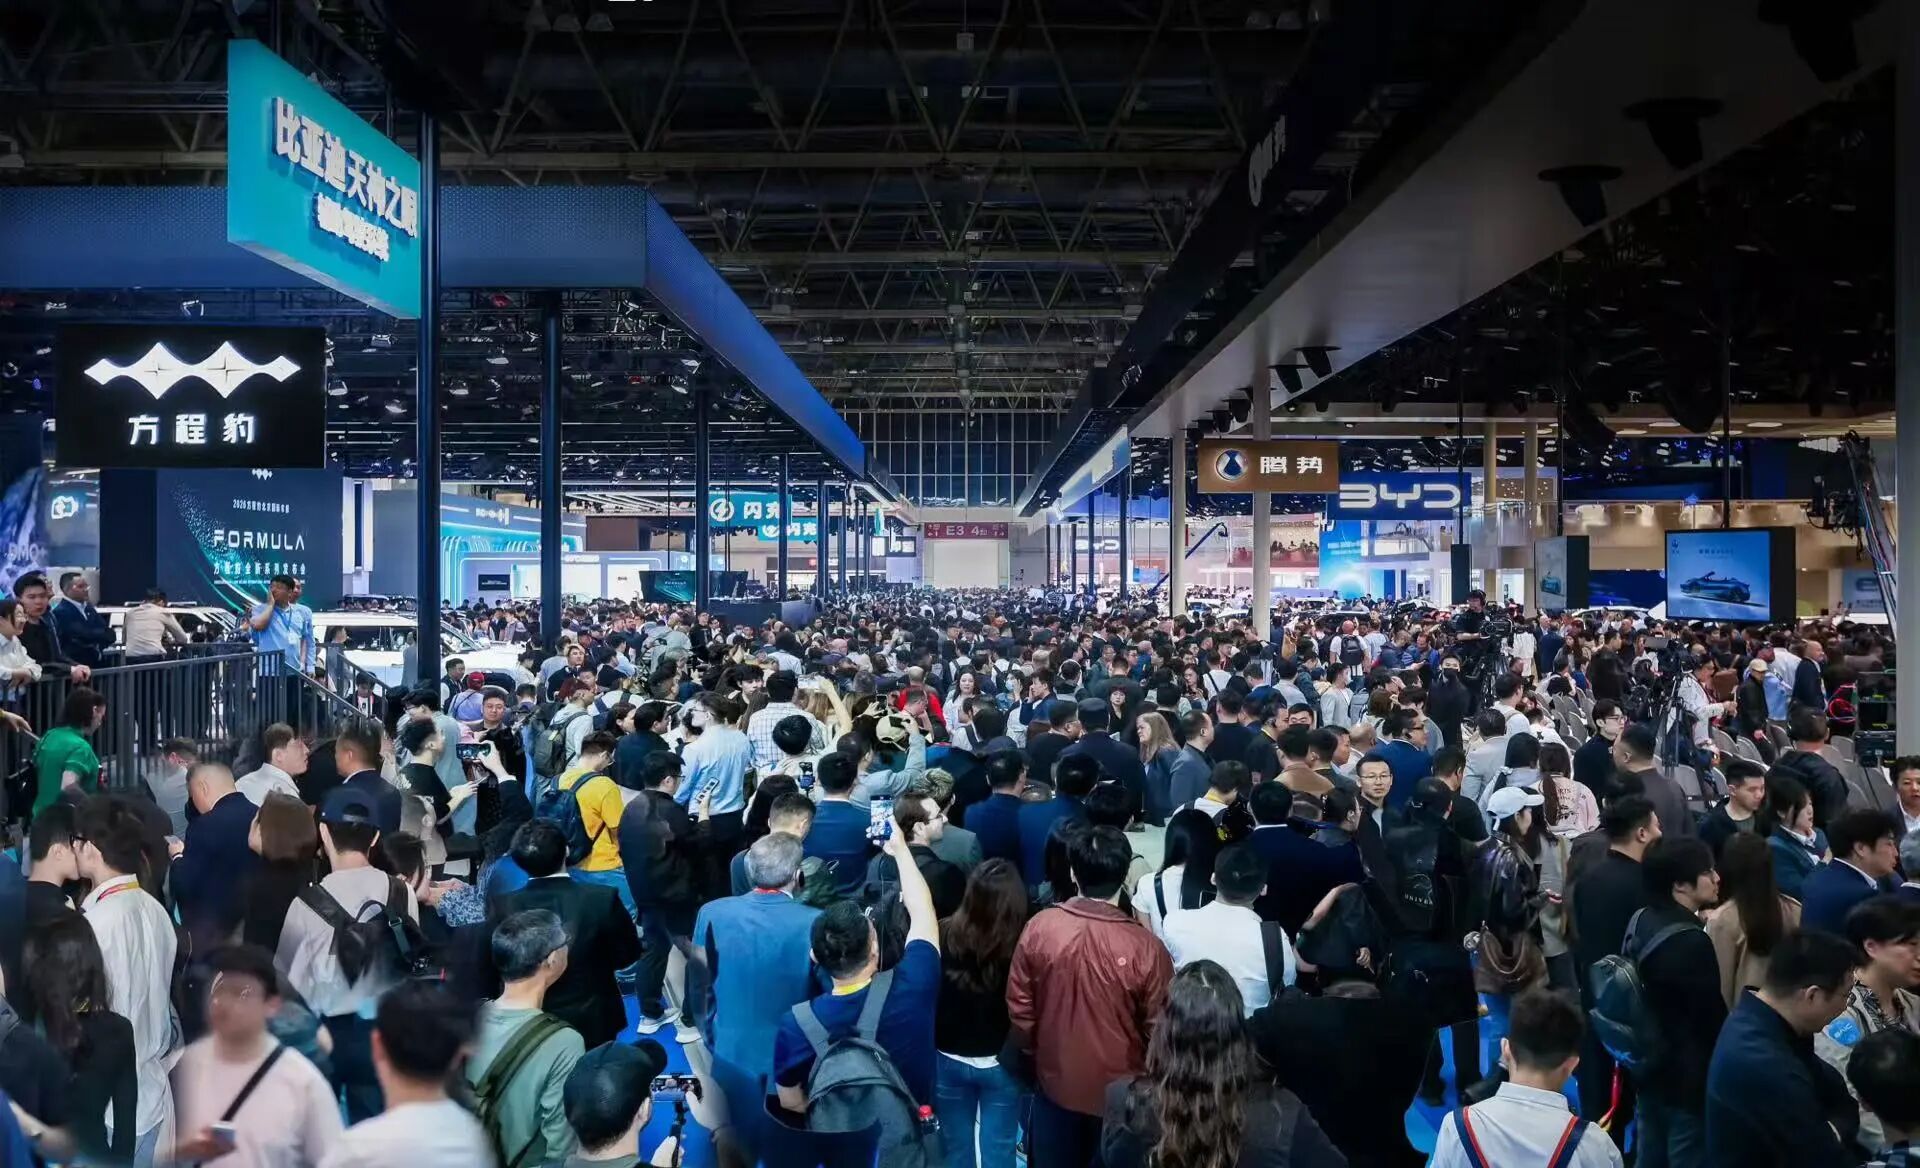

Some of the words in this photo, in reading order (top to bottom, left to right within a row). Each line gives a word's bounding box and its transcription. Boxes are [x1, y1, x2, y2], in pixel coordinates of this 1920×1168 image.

[128, 413, 256, 446] 方程豹
[1260, 456, 1323, 474] 腾势
[1339, 483, 1461, 509] BYD
[213, 530, 305, 551] FORMULA
[946, 525, 964, 536] E3
